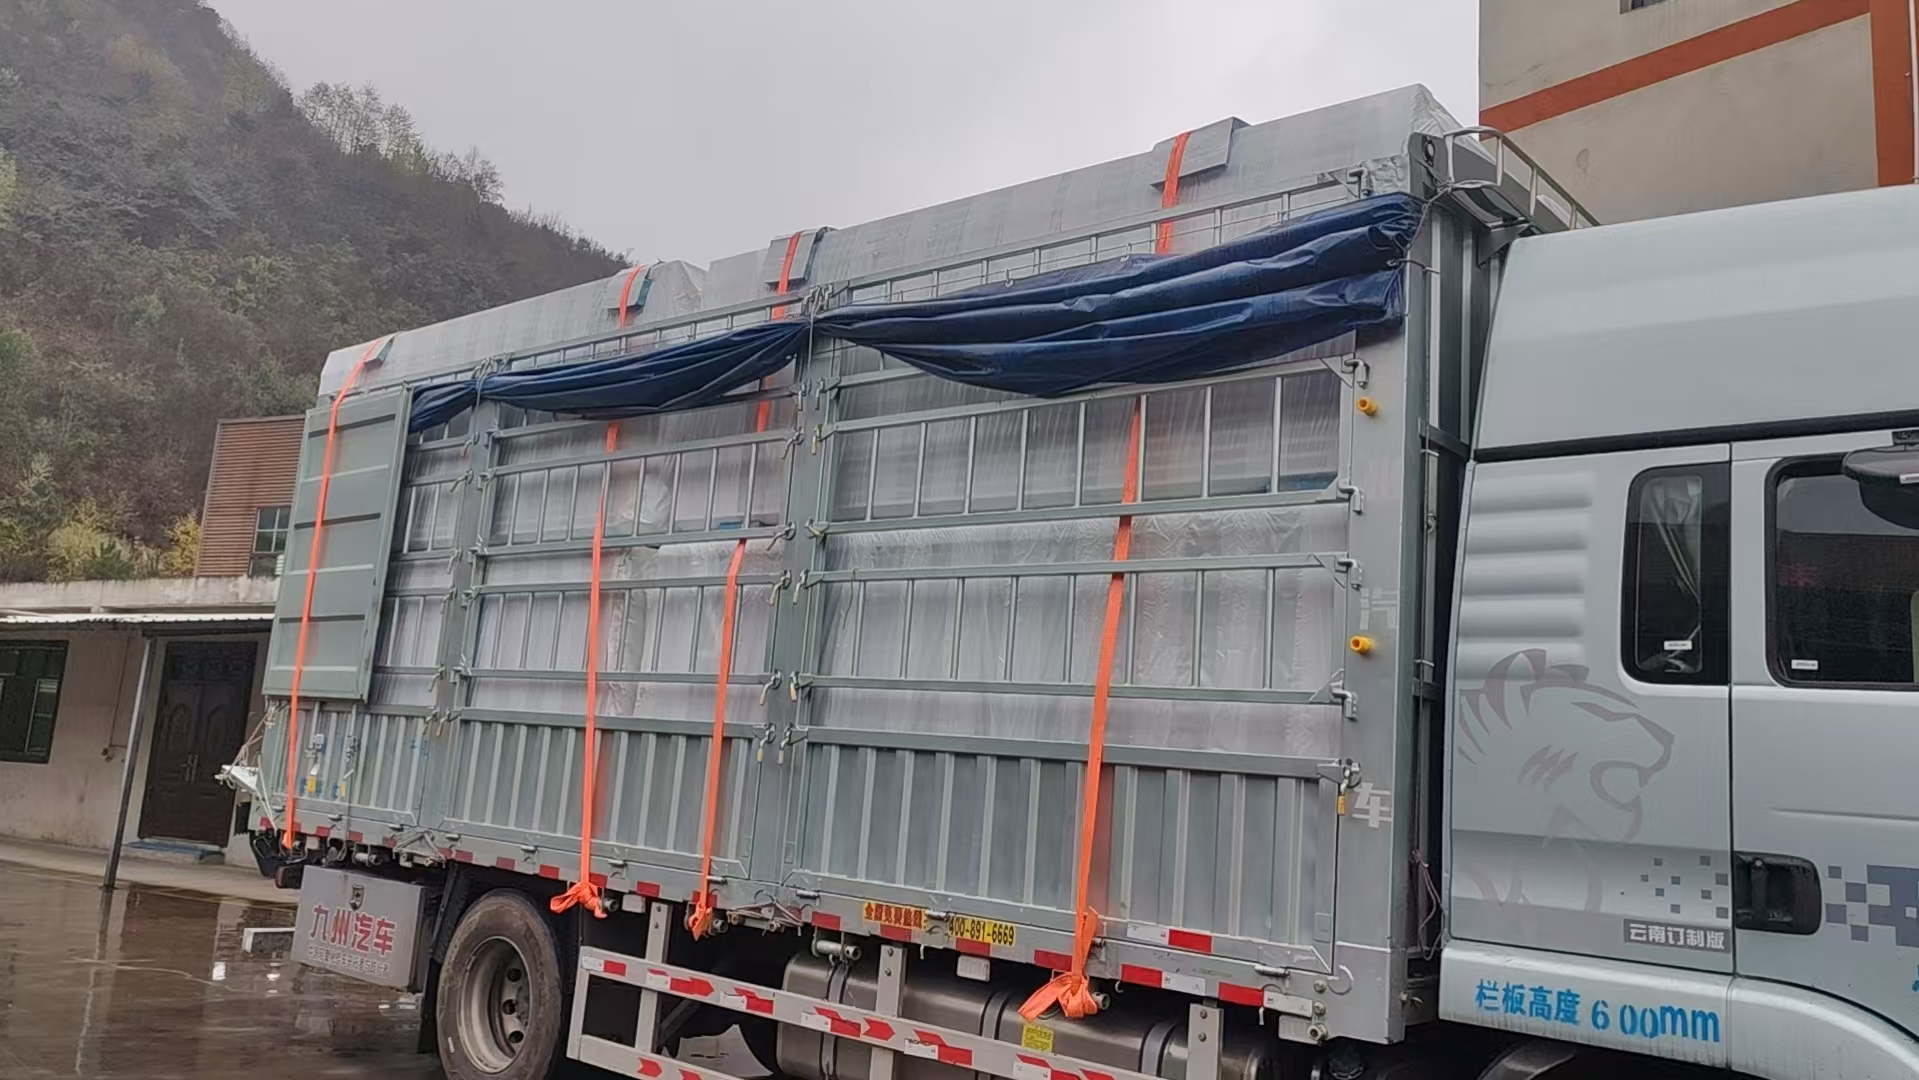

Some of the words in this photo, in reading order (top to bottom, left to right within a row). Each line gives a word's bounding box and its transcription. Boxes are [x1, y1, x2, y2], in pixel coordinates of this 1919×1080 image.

[1352, 782, 1392, 829] 车
[309, 904, 395, 956] 九州汽车
[949, 916, 1015, 946] 400-891-6669
[1629, 923, 1725, 950] 云南订制版
[1475, 979, 1581, 1026] 栏板高度
